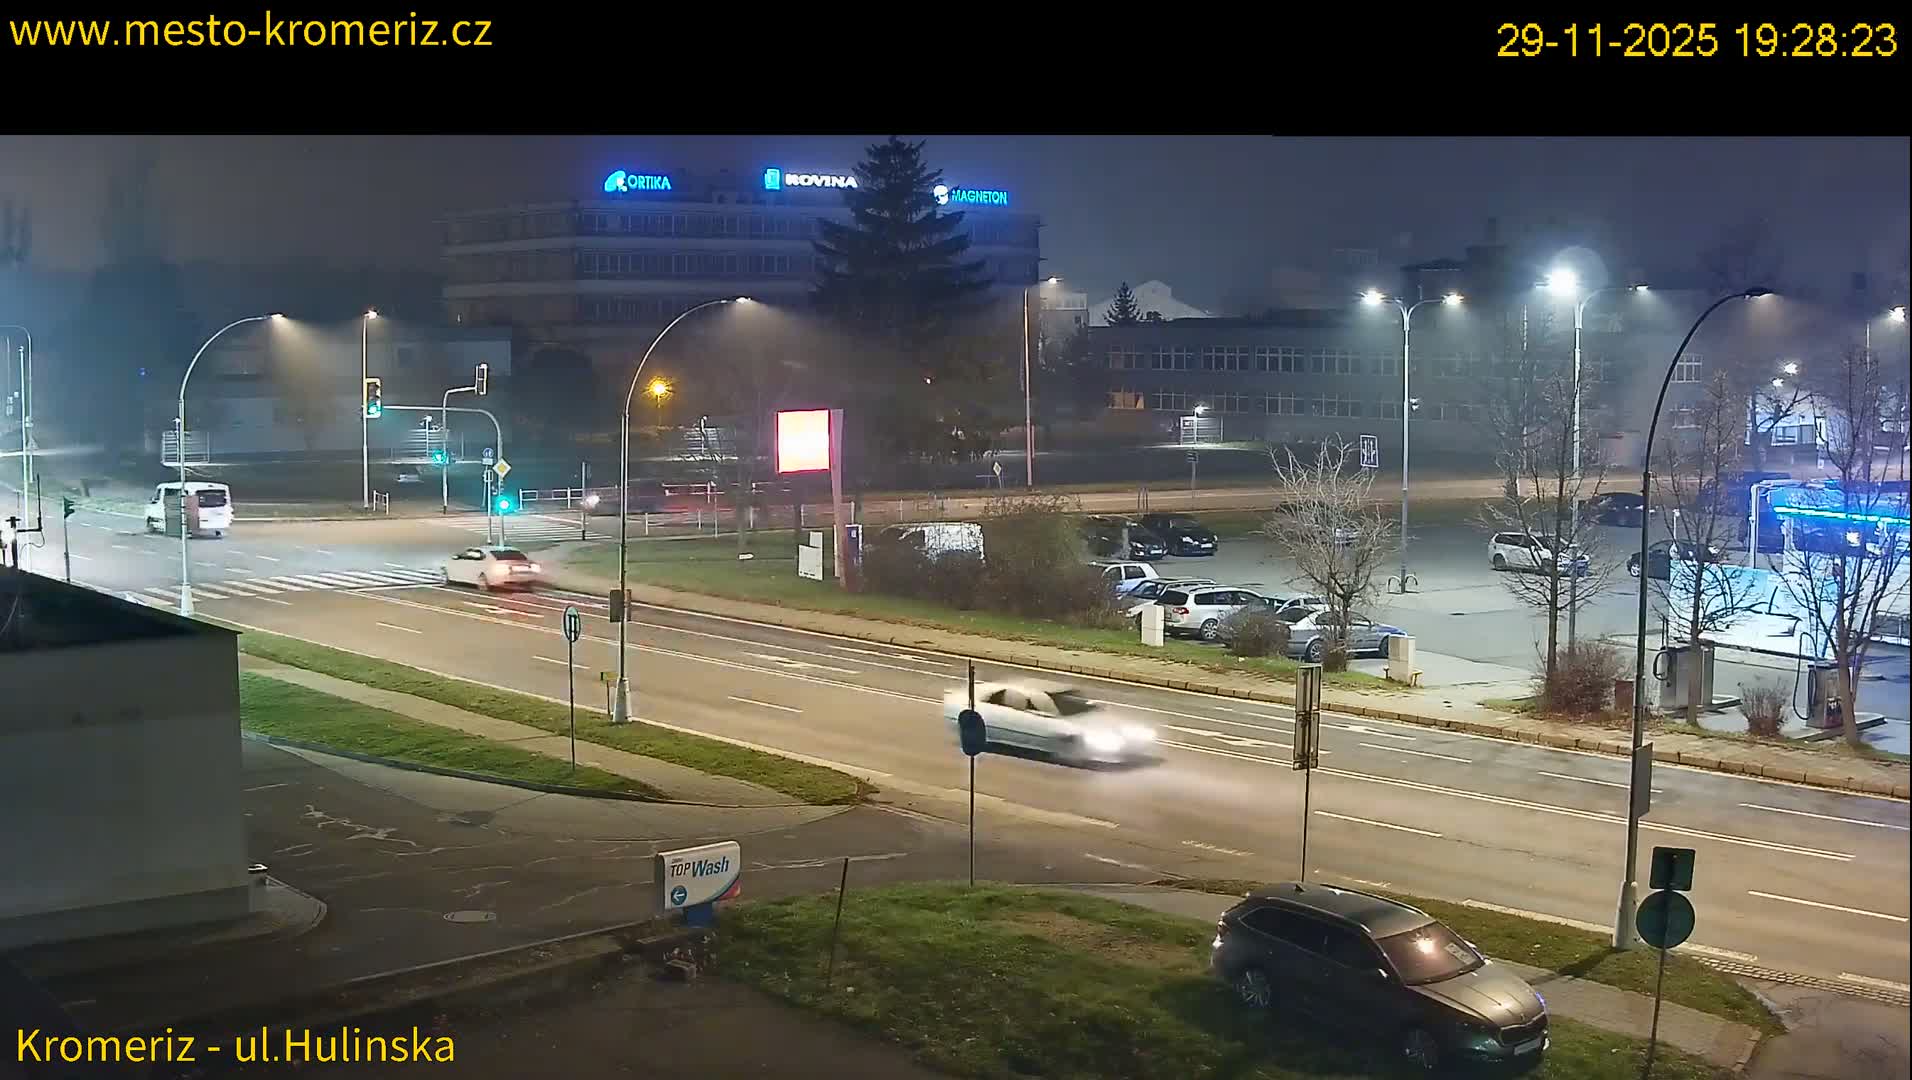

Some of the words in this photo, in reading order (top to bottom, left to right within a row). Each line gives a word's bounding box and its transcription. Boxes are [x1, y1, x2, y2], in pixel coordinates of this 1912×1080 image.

[627, 174, 672, 191] ORTIKA
[785, 173, 858, 189] ROVINA
[951, 188, 1008, 206] MAGNETON
[671, 863, 691, 877] TOP
[692, 857, 729, 877] Wash
